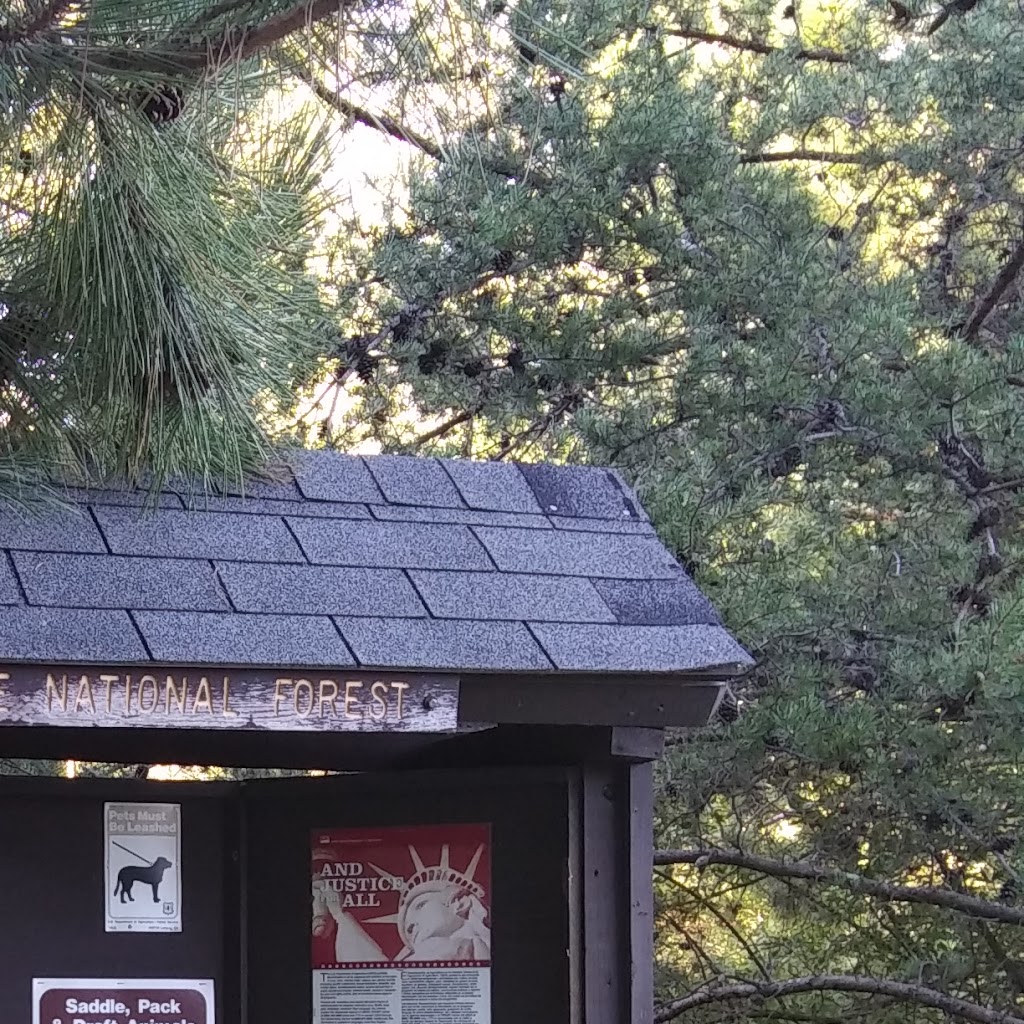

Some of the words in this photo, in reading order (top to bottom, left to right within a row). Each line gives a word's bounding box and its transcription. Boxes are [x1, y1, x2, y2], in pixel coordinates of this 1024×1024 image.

[45, 673, 240, 717] NATIONAL
[274, 678, 410, 720] FOREST
[109, 810, 135, 820] Pets
[138, 811, 166, 820] Must
[109, 822, 125, 831] Be
[127, 822, 176, 833] Leashed
[320, 862, 363, 877] AND
[324, 876, 404, 892] JUSTICE
[342, 893, 381, 908] ALL
[65, 998, 131, 1016] Saddle,
[138, 999, 182, 1014] Pack
